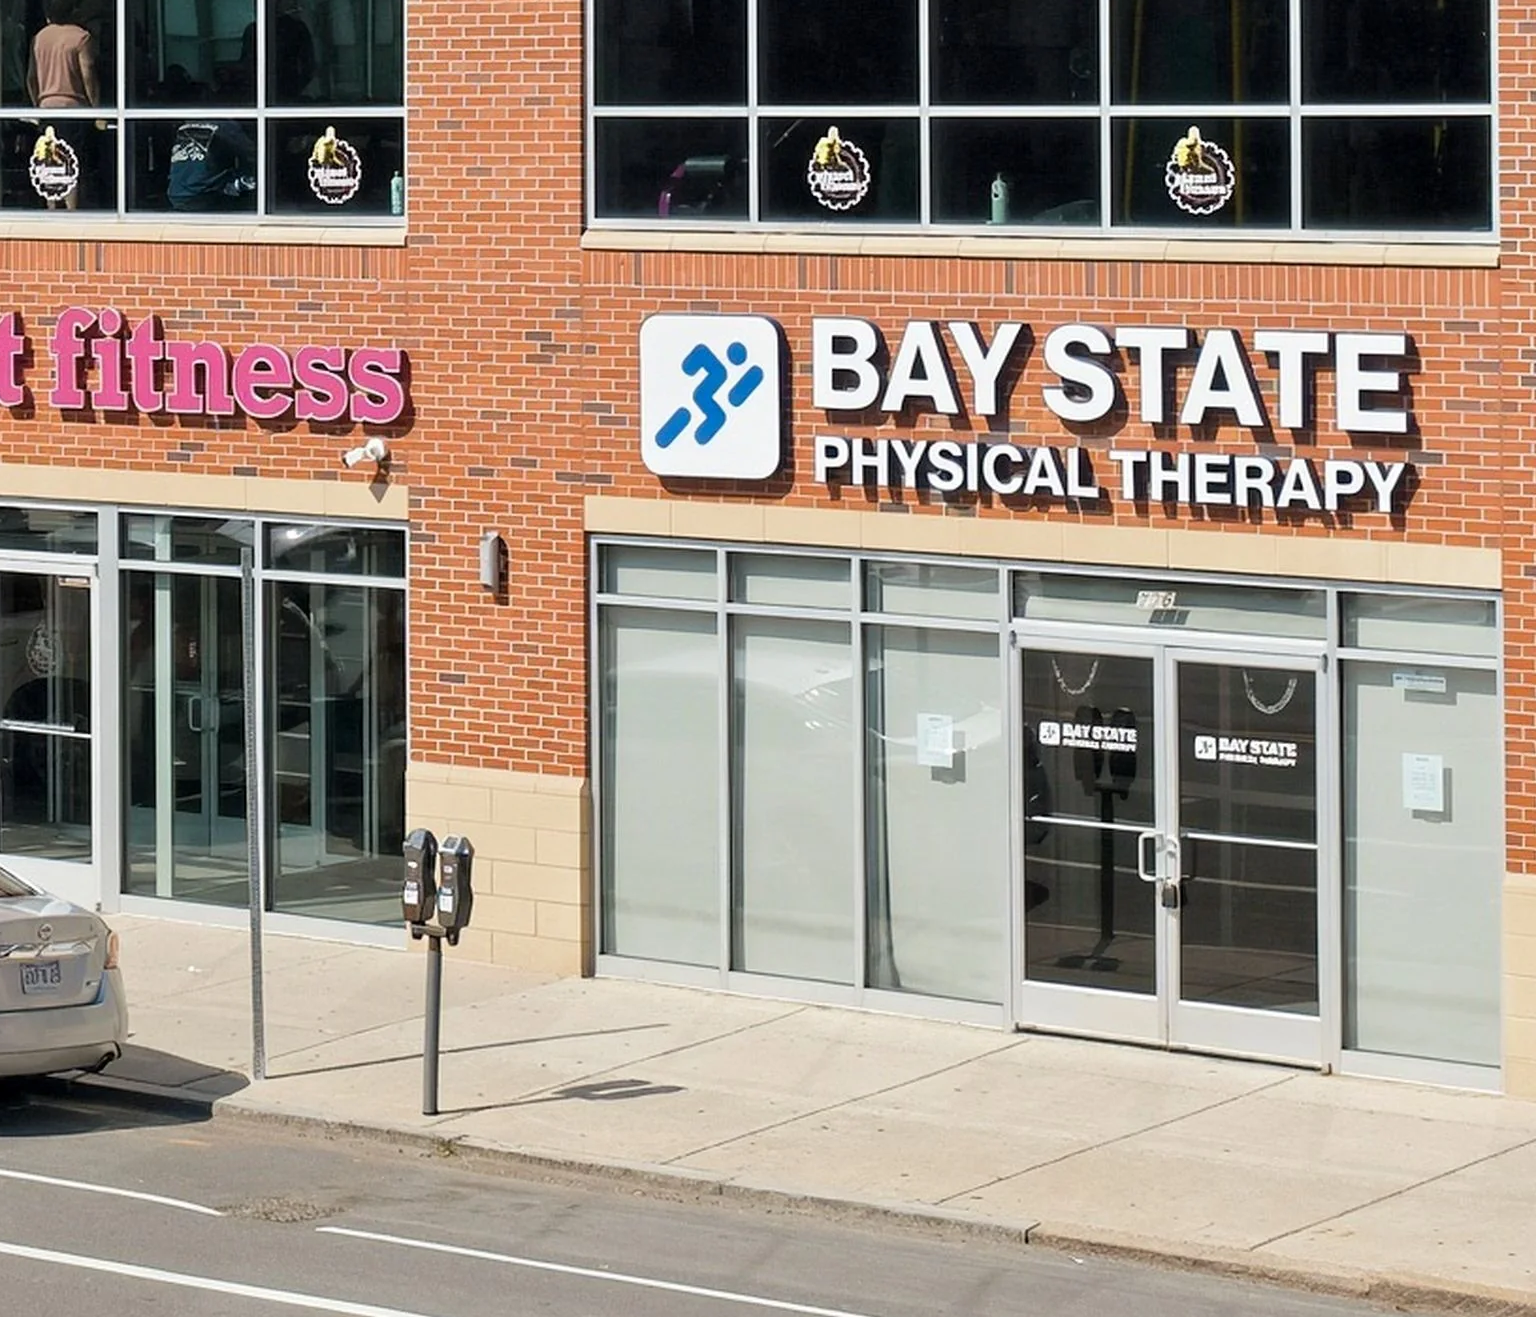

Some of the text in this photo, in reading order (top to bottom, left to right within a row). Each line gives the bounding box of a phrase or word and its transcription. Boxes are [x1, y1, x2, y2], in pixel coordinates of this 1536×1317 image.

[49, 306, 405, 424] fitness
[812, 317, 1408, 433] BAY STATE
[814, 435, 1406, 514] PHYSICAL THERAPY
